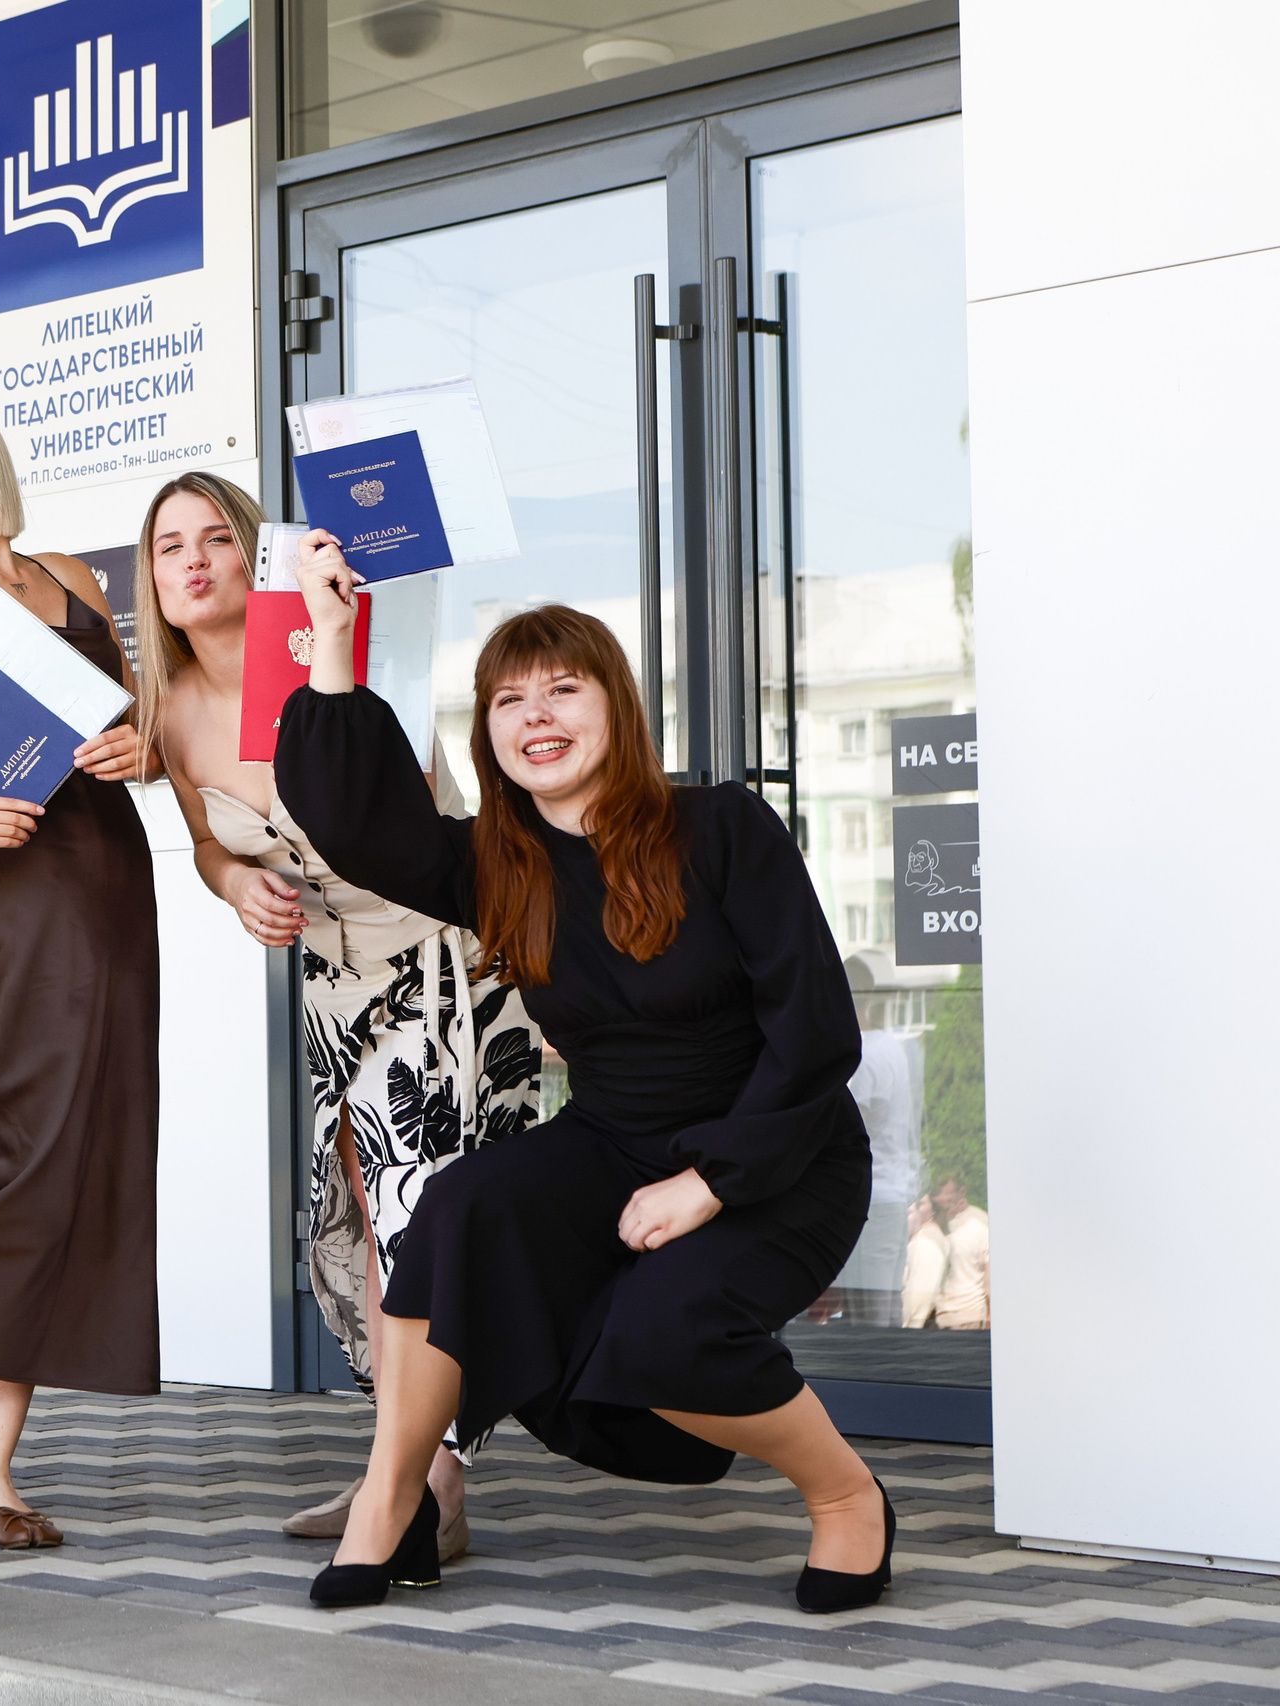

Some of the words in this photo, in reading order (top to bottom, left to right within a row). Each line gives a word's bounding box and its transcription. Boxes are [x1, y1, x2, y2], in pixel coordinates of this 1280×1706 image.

[42, 294, 153, 346] ЛИПЕЦКИЙ
[4, 362, 194, 428] ПЕДАГОГИЧЕСКИЙ
[30, 413, 167, 460] УНИВЕРСИТЕТ
[31, 443, 212, 485] П.П.Семенова-Тян-Шанского
[352, 525, 407, 545] ДИПЛОМ
[0, 735, 36, 779] ДИПЛОМ
[900, 744, 937, 767] НА
[945, 741, 979, 765] СЕ
[923, 909, 982, 935] ВХО
